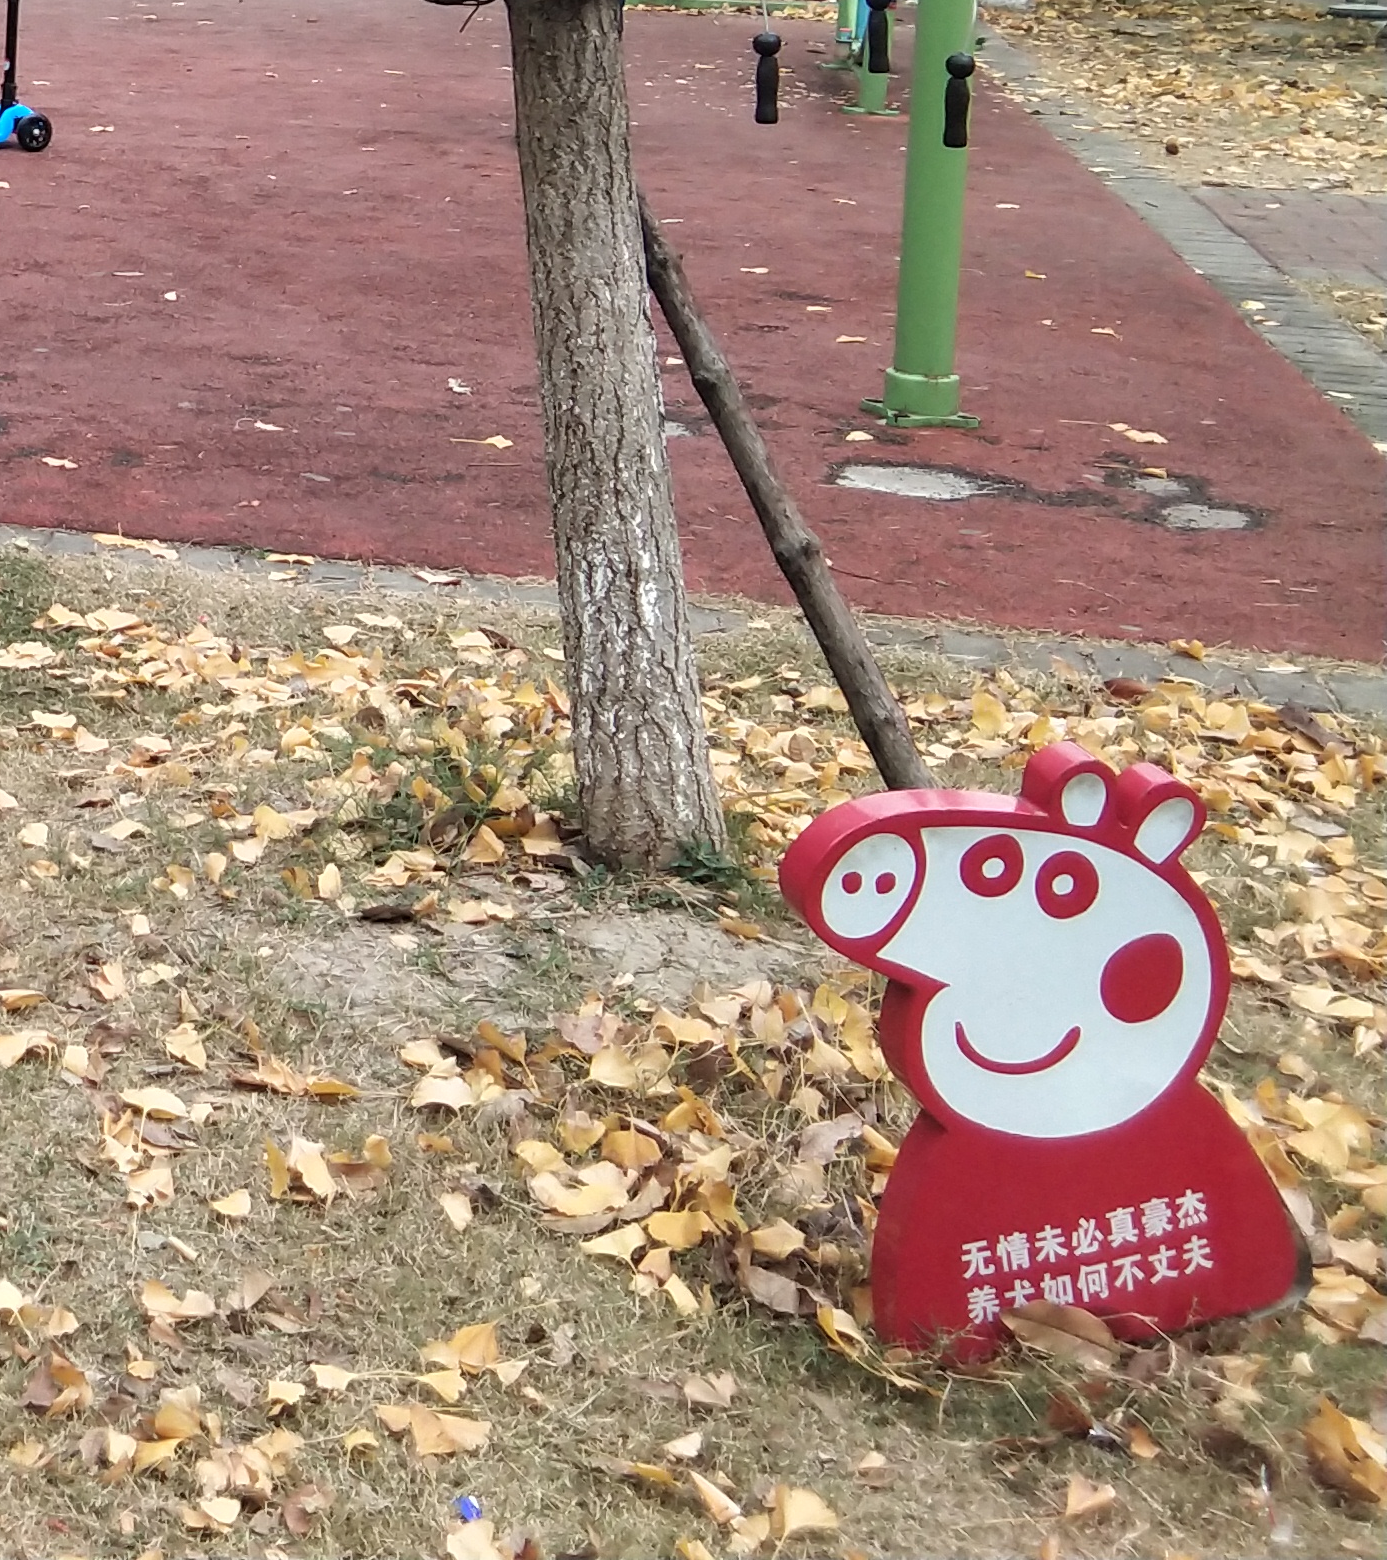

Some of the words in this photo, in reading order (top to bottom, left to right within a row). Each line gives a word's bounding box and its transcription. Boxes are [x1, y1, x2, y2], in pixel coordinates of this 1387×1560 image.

[961, 1188, 1208, 1278] 无情未必真豪杰
[966, 1234, 1214, 1325] 养犬如何不丈夫
